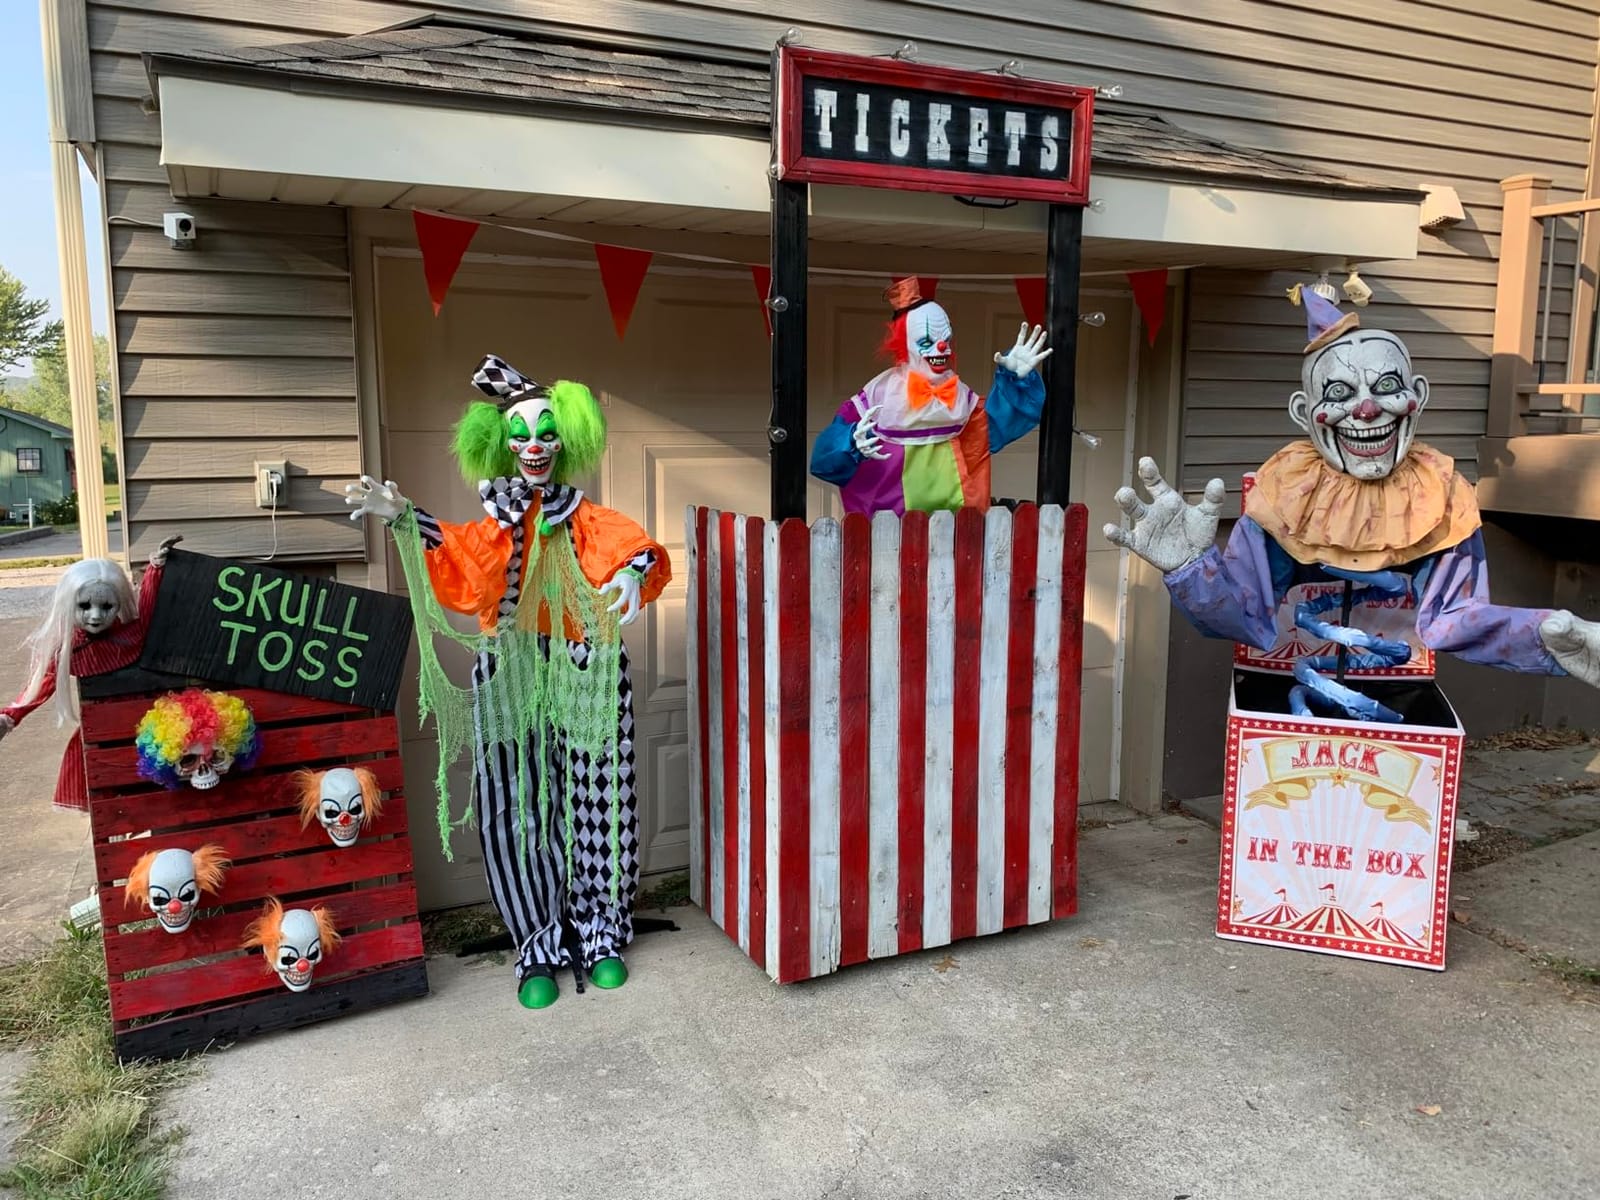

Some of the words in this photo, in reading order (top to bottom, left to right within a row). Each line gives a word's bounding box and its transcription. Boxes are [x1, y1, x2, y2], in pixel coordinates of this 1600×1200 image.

[814, 88, 1060, 172] TICKETS
[212, 566, 370, 642] SKULL
[220, 620, 364, 689] TOSS
[1291, 739, 1387, 778] JACK
[1247, 836, 1279, 863] IN
[1291, 840, 1353, 871] THE
[1365, 848, 1427, 880] BOX
